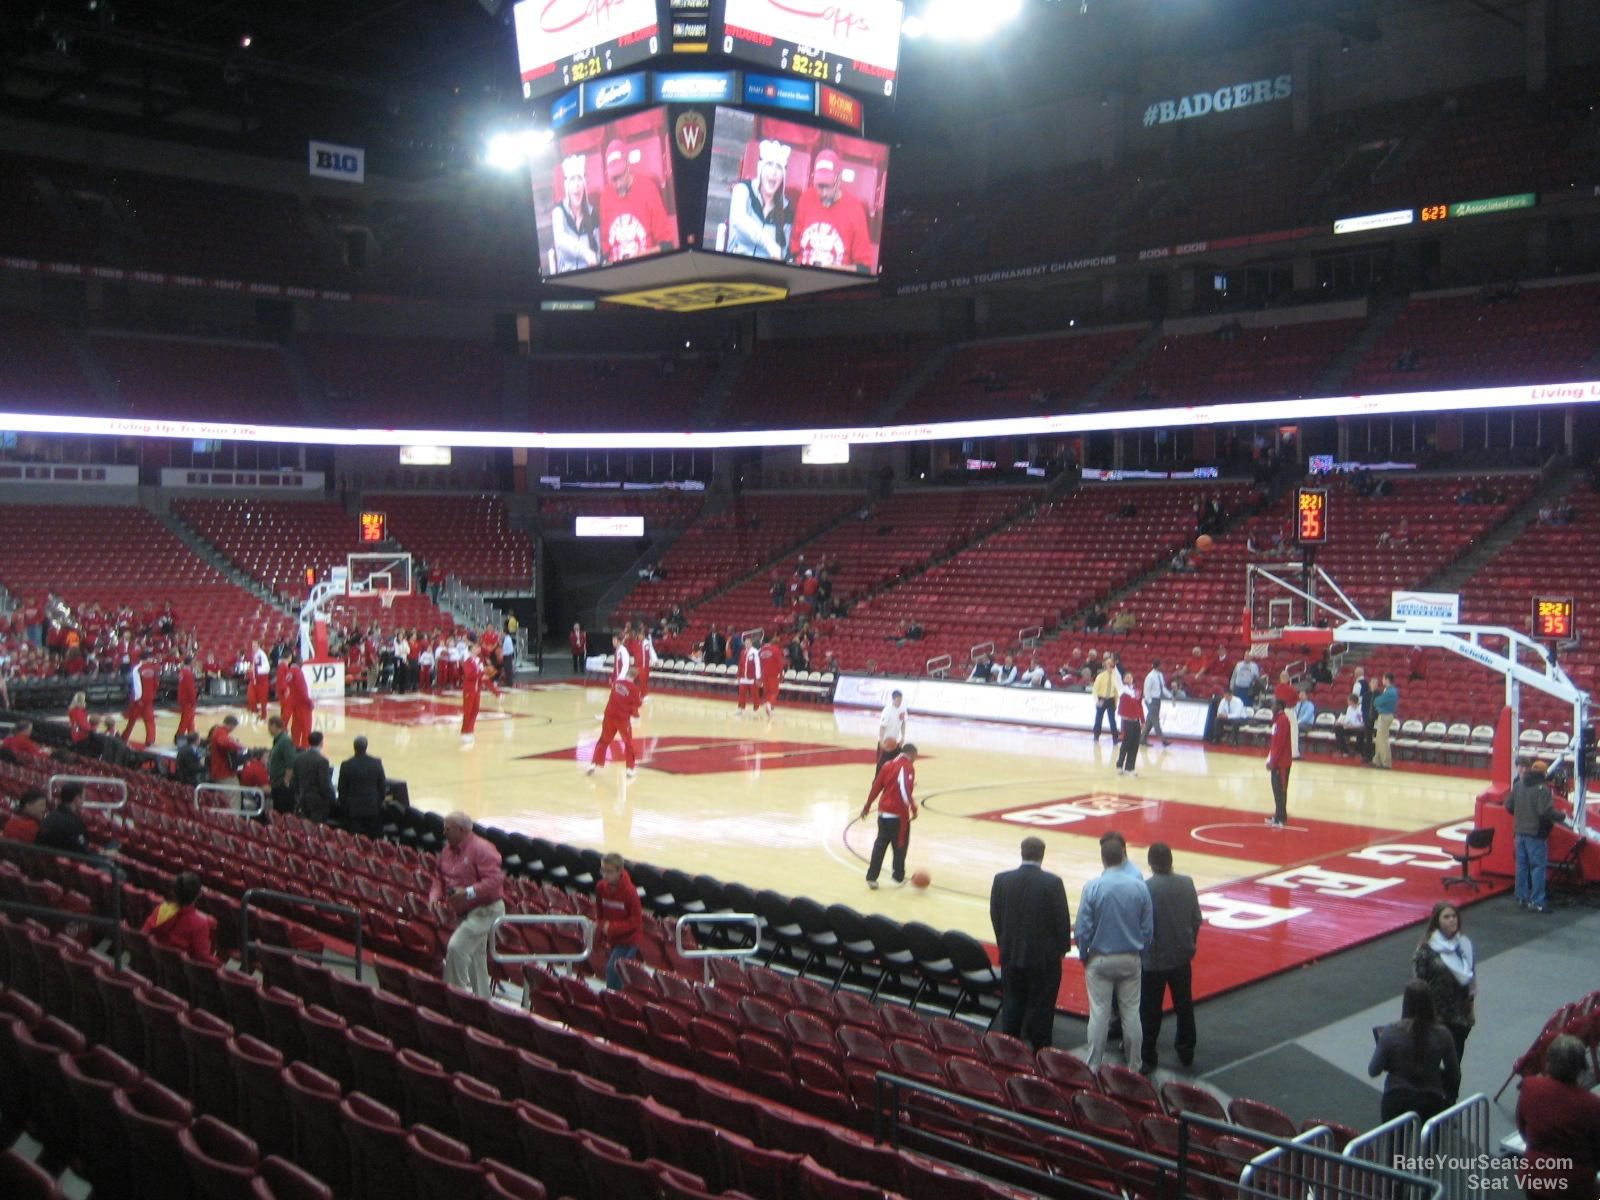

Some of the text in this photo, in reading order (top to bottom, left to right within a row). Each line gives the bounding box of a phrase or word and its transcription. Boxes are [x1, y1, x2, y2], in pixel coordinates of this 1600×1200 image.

[1143, 74, 1292, 127] #BADGERS
[683, 125, 699, 150] W
[1421, 205, 1446, 222] 6:23
[950, 276, 970, 288] TEN
[973, 265, 1048, 285] TOURNAMENT
[1050, 254, 1117, 273] CHAMPIONS
[1531, 387, 1584, 399] Living
[364, 524, 381, 540] 35
[1302, 510, 1319, 537] 35
[1539, 602, 1570, 616] 32:21
[1544, 616, 1564, 633] 35
[312, 665, 336, 684] yp
